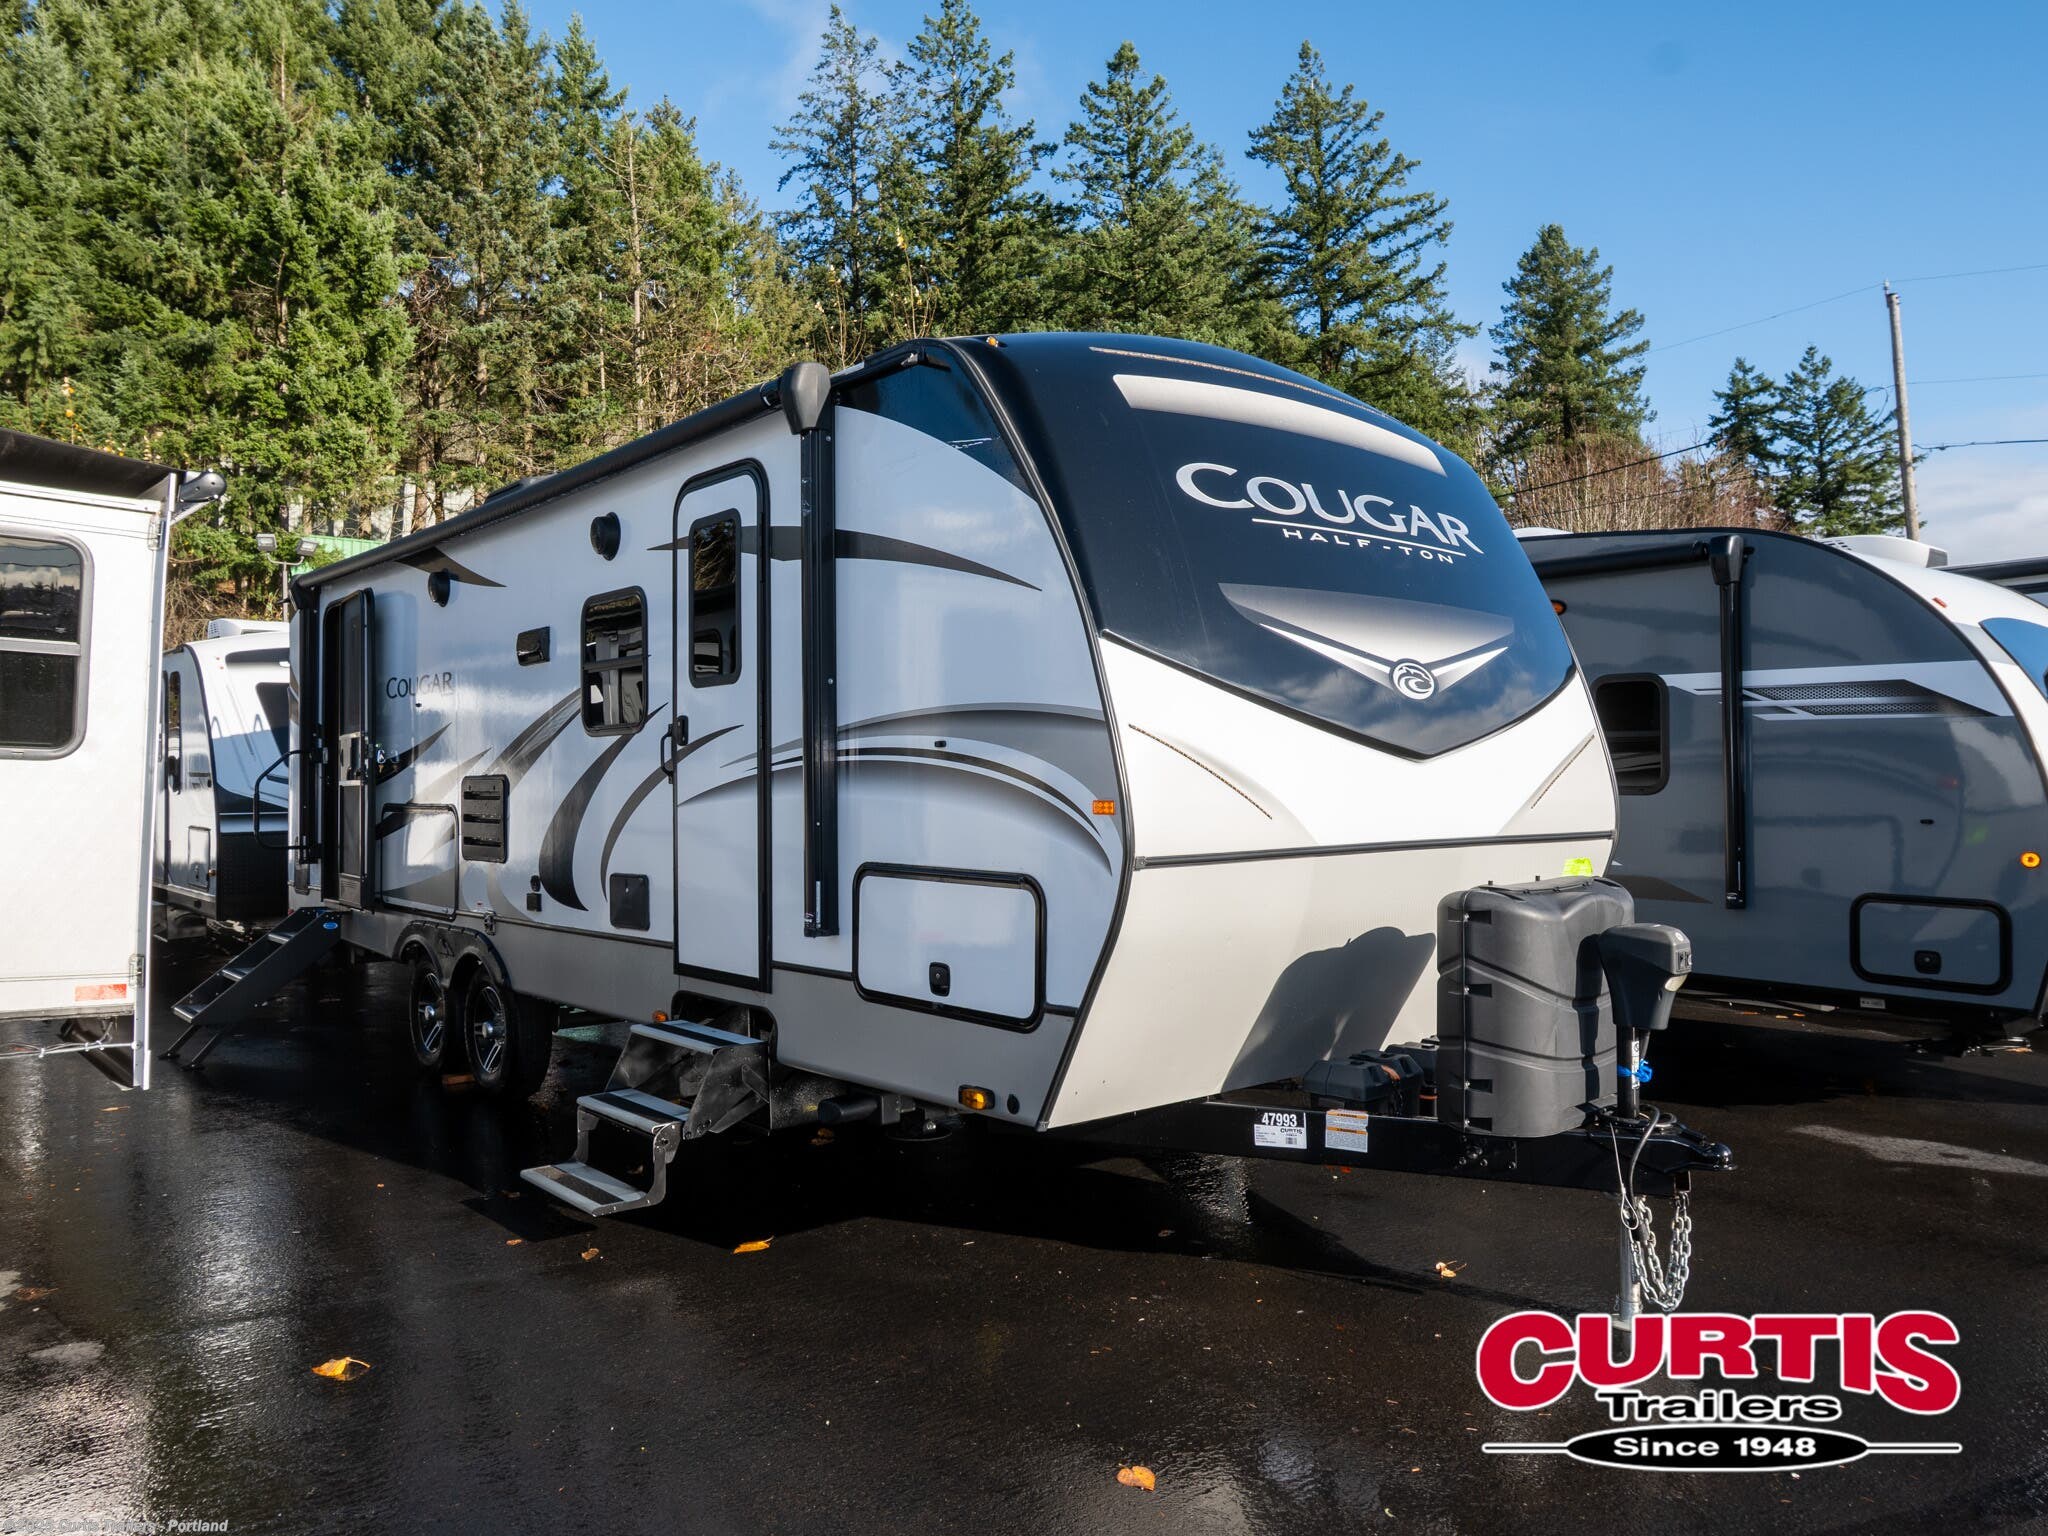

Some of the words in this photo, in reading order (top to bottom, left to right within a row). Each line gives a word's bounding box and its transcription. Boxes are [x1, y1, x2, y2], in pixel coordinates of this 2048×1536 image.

[1176, 462, 1485, 554] COUGAR
[386, 671, 455, 699] COUGAR
[1261, 1112, 1298, 1127] 47993
[1280, 1127, 1303, 1135] CURTIS
